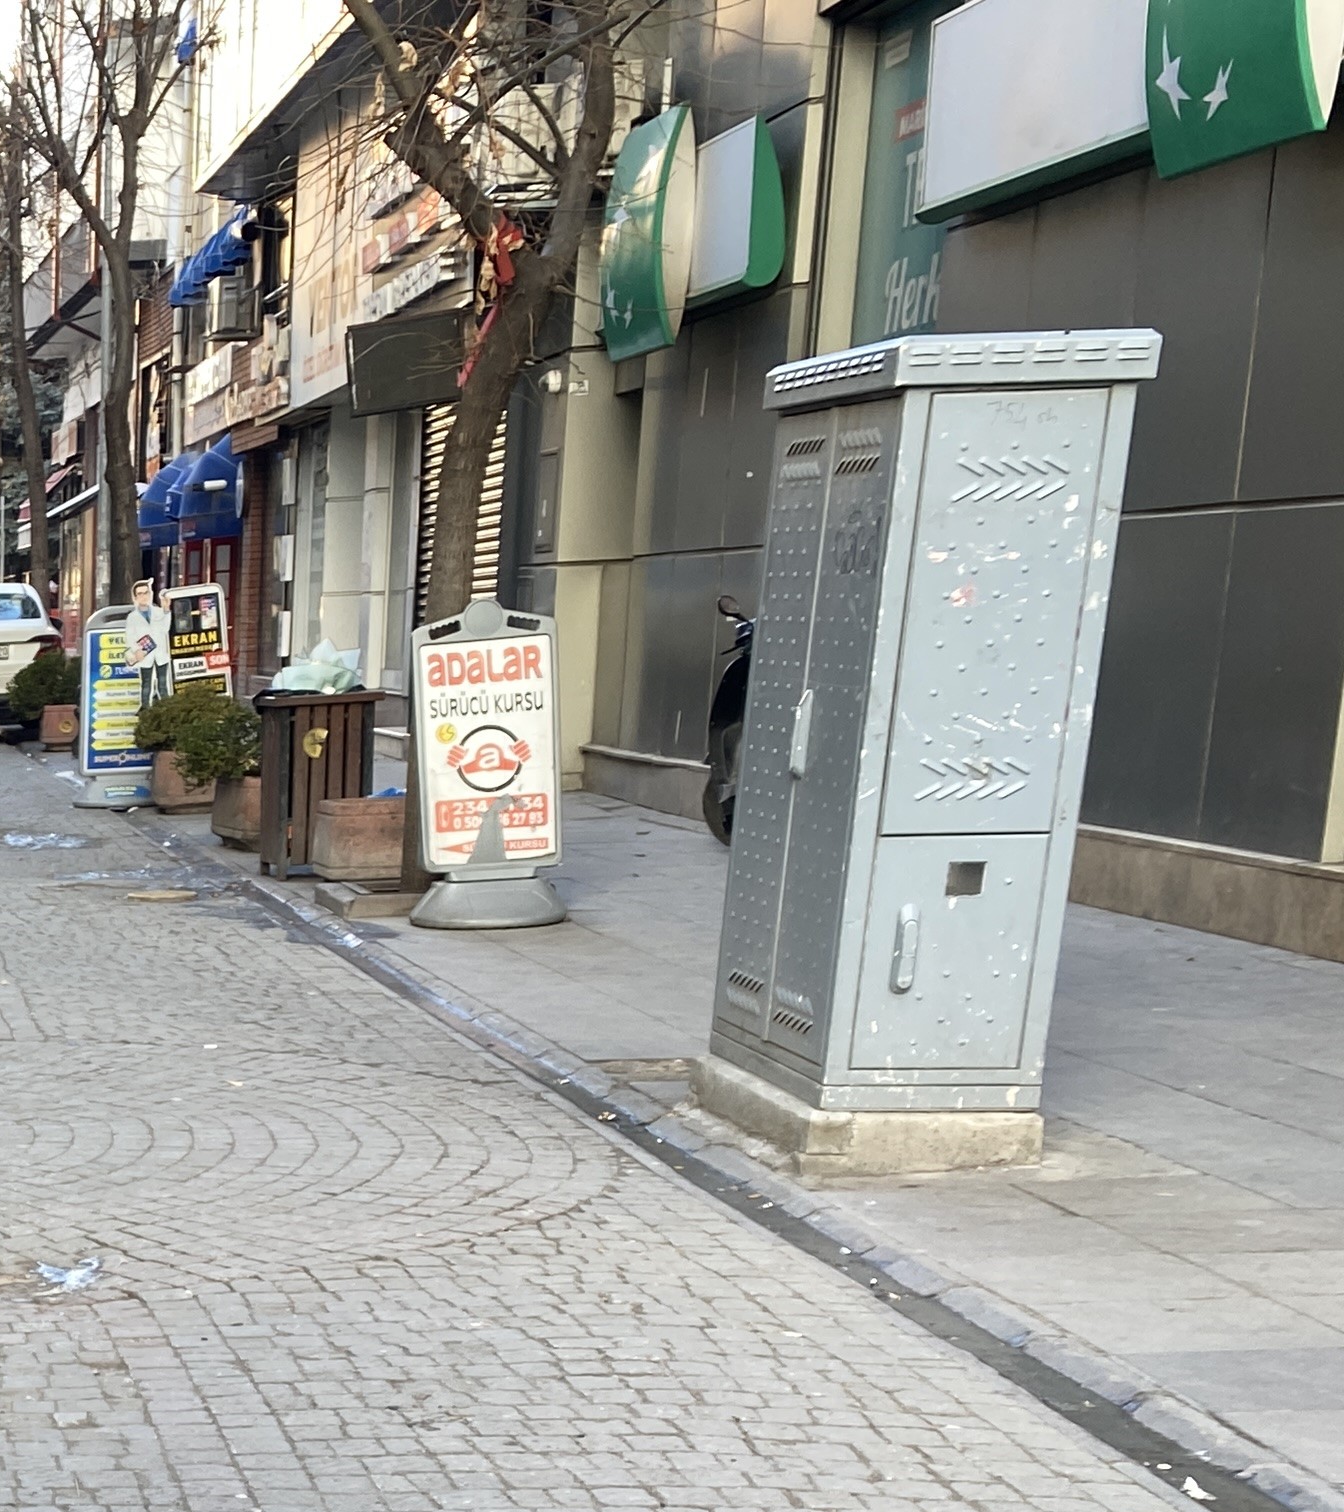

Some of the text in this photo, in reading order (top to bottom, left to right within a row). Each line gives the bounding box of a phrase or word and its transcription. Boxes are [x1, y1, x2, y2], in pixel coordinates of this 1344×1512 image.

[173, 630, 218, 648] EKRAN
[178, 660, 204, 670] EKRAN
[429, 690, 544, 719] SÜRÜCÜ KURSU
[508, 838, 547, 850] KURSU
